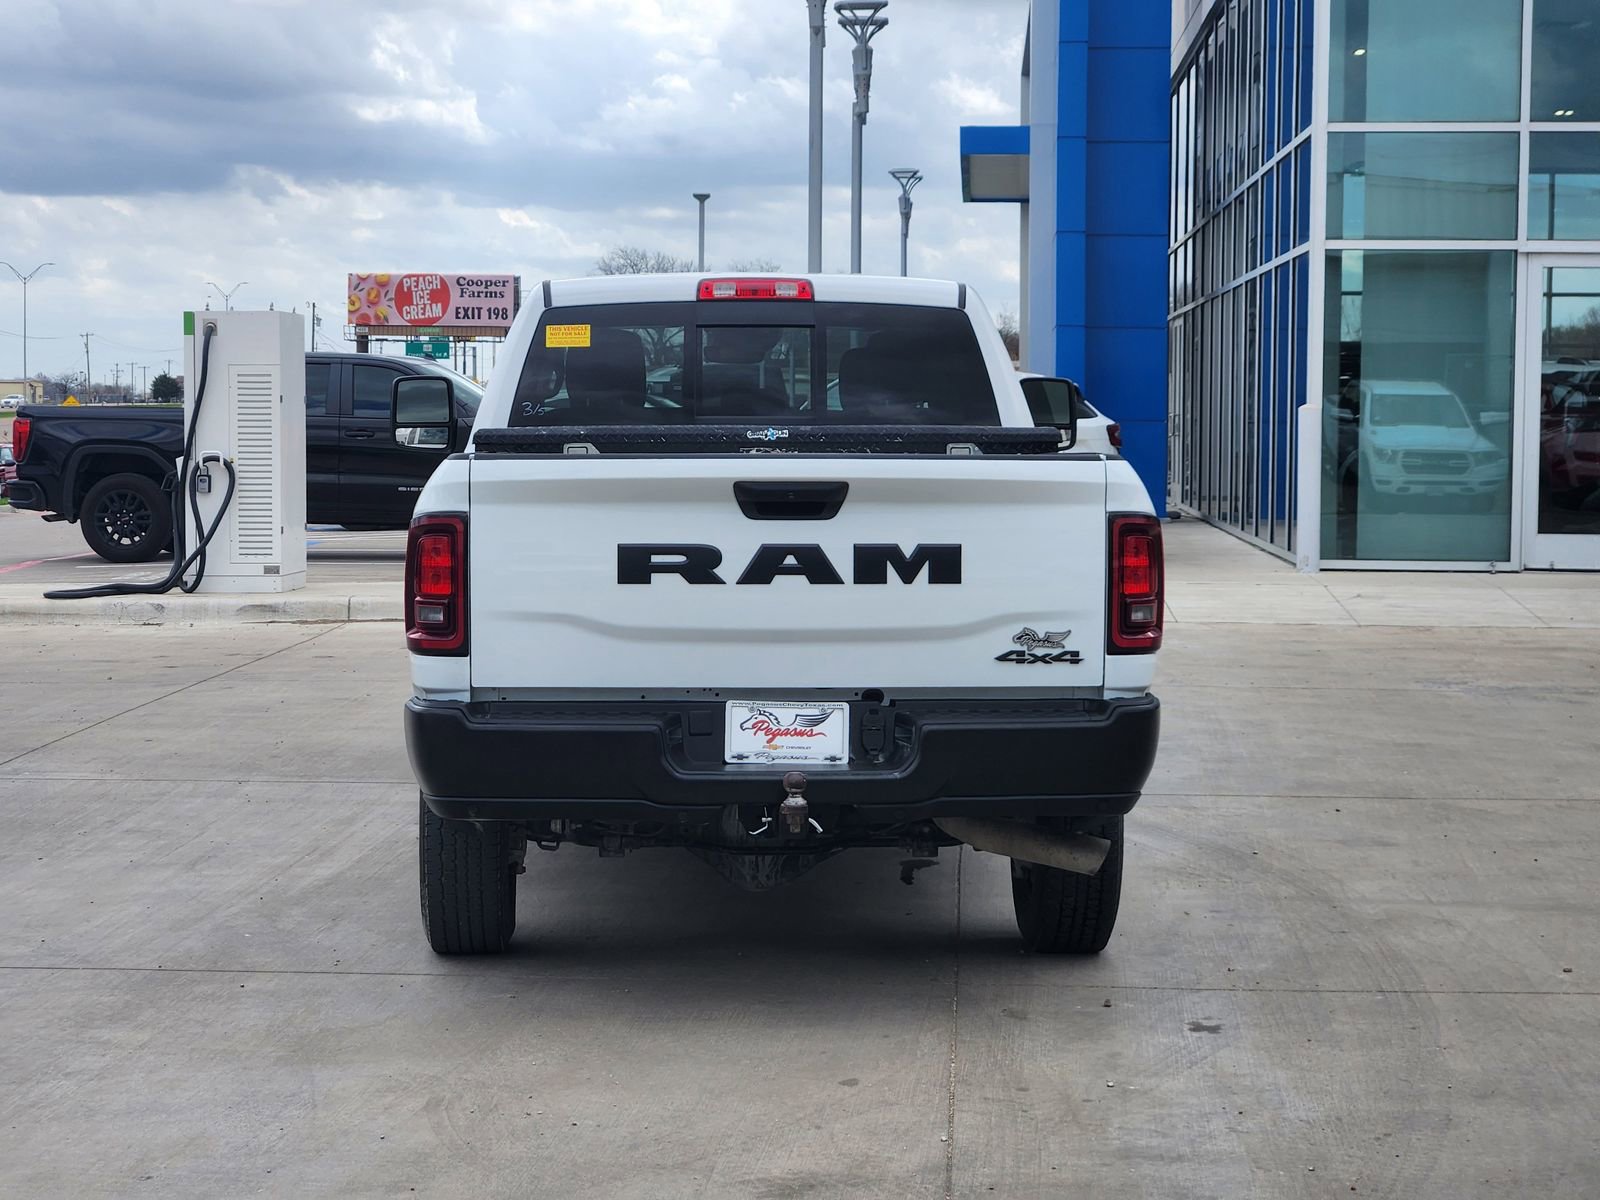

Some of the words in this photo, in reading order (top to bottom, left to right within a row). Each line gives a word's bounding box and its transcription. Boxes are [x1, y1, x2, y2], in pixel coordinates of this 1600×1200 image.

[403, 275, 441, 291] PEACH
[456, 276, 509, 290] Cooper
[412, 290, 431, 304] ICE
[459, 288, 505, 299] Farms
[402, 303, 442, 320] CREAM
[455, 306, 483, 320] EXIT
[487, 306, 509, 321] 198
[617, 543, 962, 585] RAM
[994, 650, 1084, 664] 4x4
[752, 720, 827, 744] Pegasus
